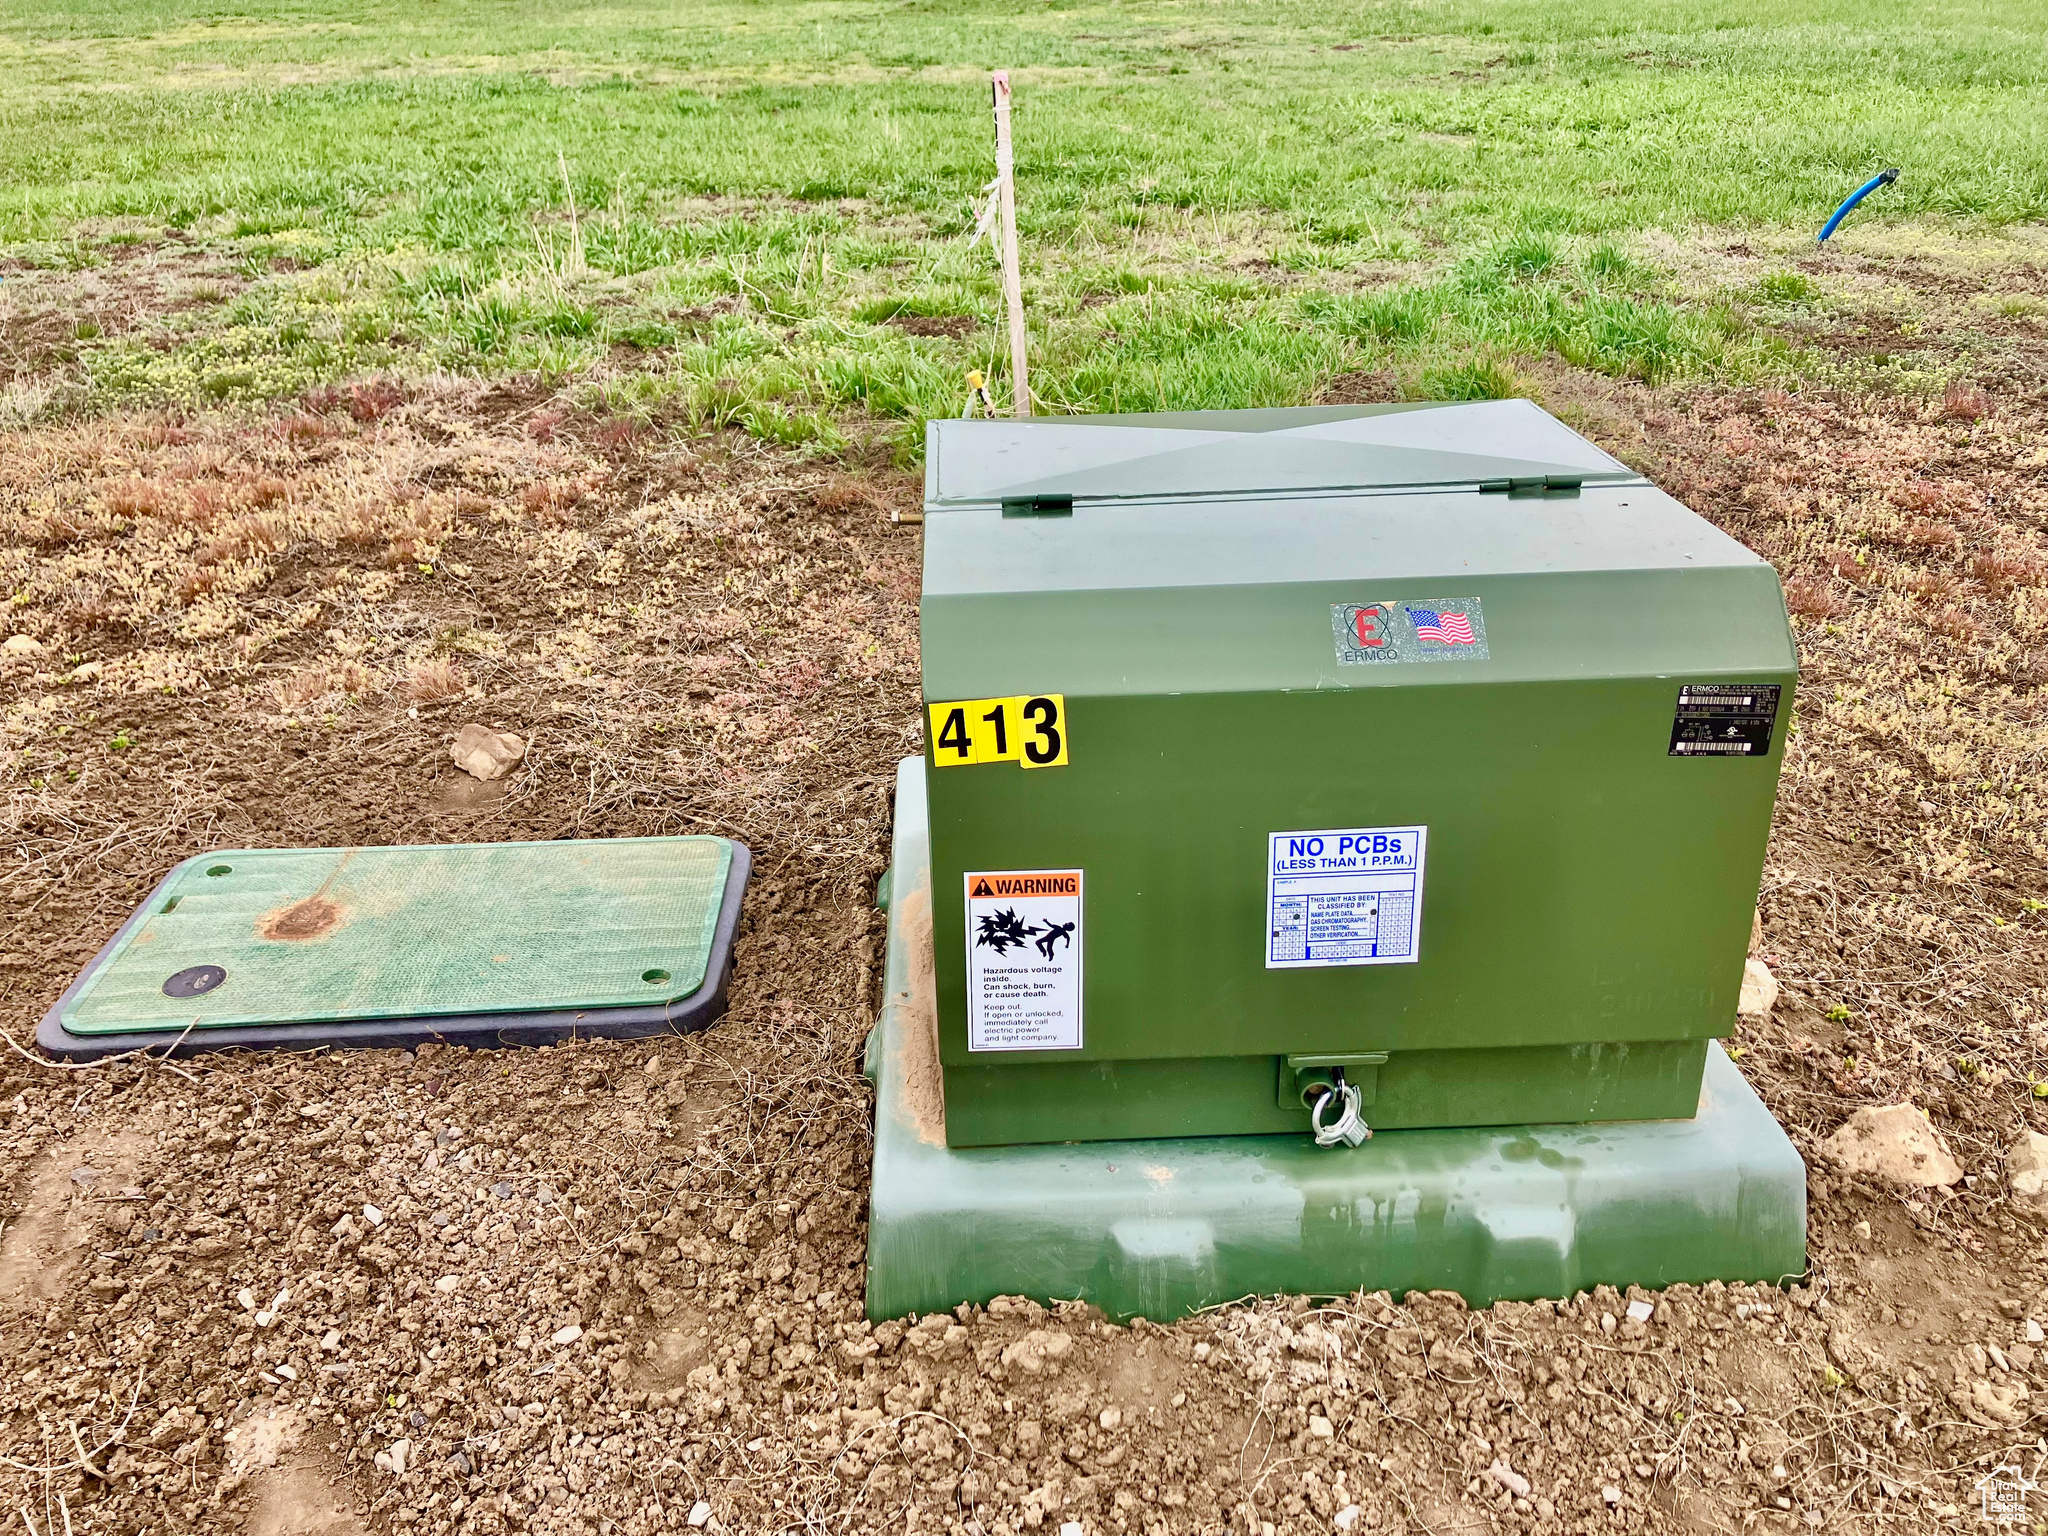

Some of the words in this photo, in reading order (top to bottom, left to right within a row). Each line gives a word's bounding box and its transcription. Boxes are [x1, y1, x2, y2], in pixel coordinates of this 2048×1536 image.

[1355, 609, 1384, 646] E
[1345, 649, 1398, 662] ERMCO
[938, 697, 1061, 764] 413
[1289, 838, 1324, 857] NO
[1339, 835, 1402, 855] PCBs
[1276, 859, 1316, 872] (LESS
[1320, 857, 1357, 868] THAN
[1361, 857, 1366, 866] 1
[1372, 854, 1412, 866] P.P.M.)
[995, 877, 1076, 895] WARNING
[1317, 902, 1356, 910] CLASSIFIED
[1031, 966, 1063, 975] voltage
[983, 975, 1012, 983] inside.
[1003, 983, 1031, 991] shock,
[1033, 982, 1056, 990] burn,
[1023, 990, 1049, 998] death.
[984, 1003, 1006, 1012] Keep
[1025, 1010, 1064, 1018] unlocked,
[984, 1019, 1033, 1027] immediately
[1015, 1026, 1041, 1034] power
[1002, 1034, 1019, 1043] light
[1021, 1034, 1059, 1043] company.
